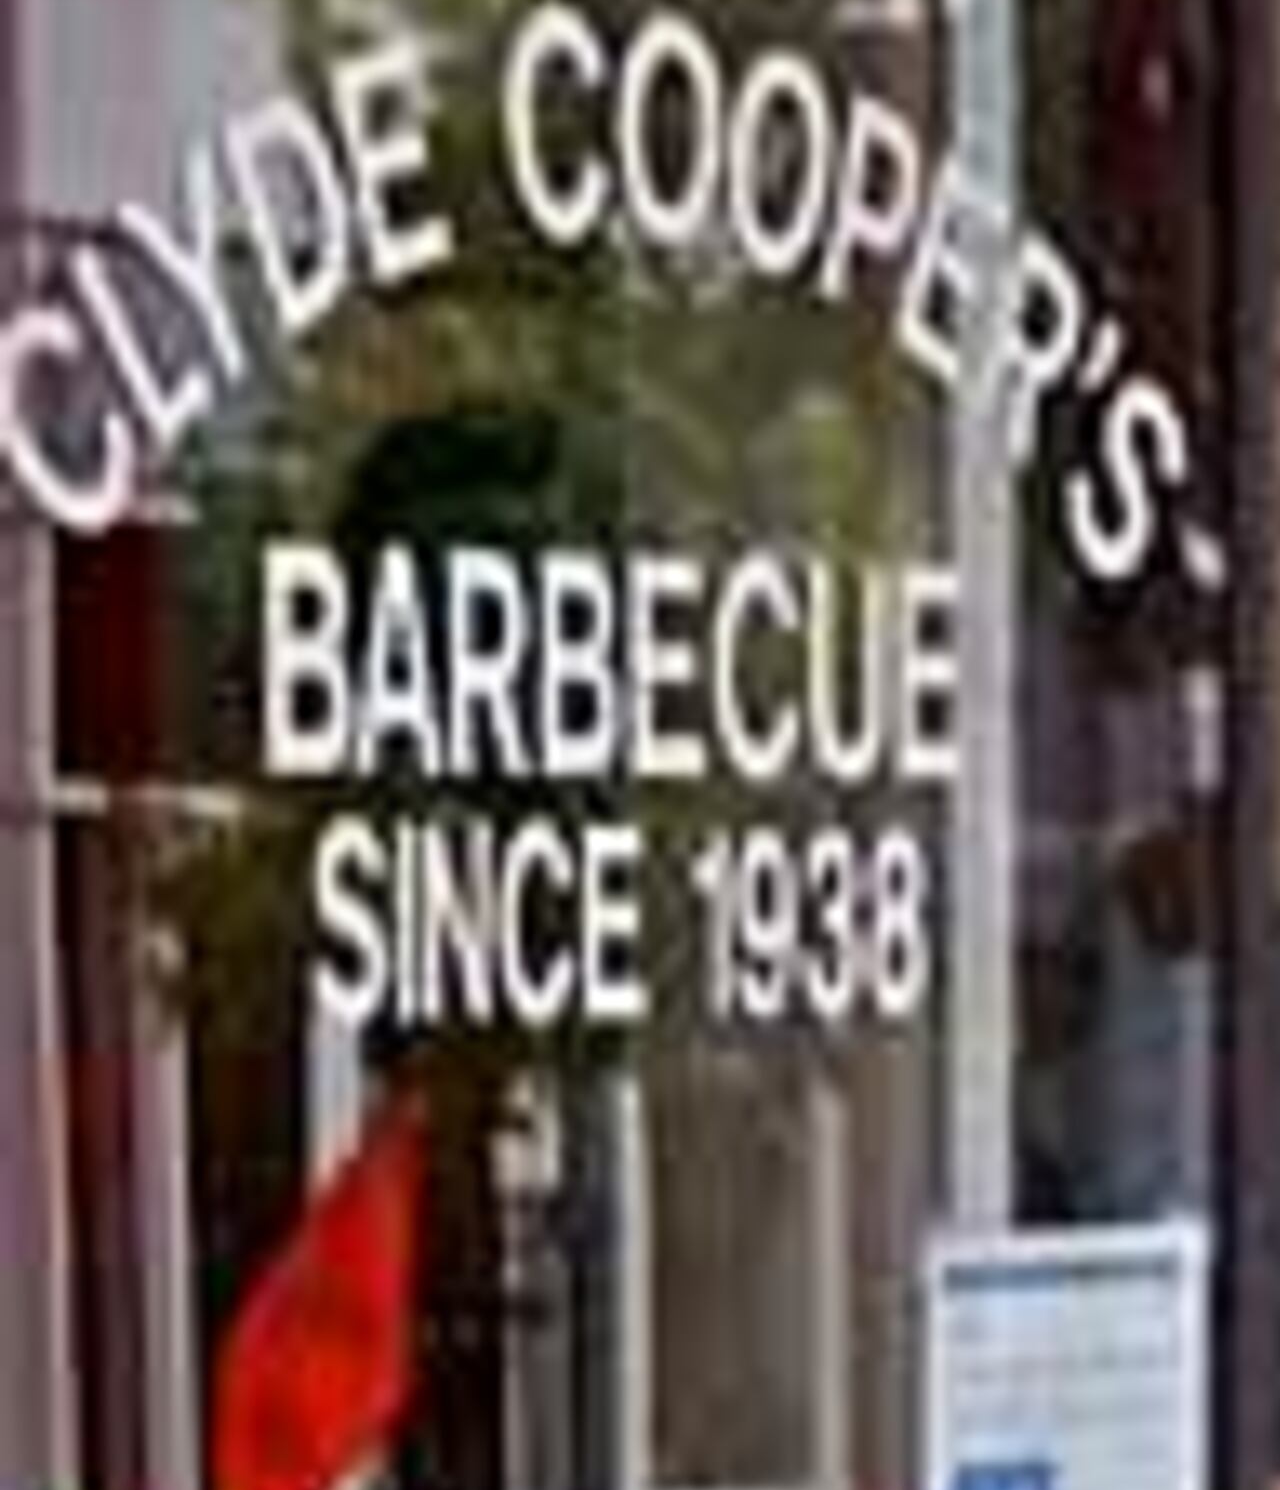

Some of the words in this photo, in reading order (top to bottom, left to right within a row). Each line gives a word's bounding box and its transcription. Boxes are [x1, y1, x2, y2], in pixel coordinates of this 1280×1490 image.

[0, 35, 453, 532] CLYDE
[262, 540, 962, 782] BARBECUE
[310, 815, 645, 1025] SINCE
[695, 828, 930, 1018] 1938
